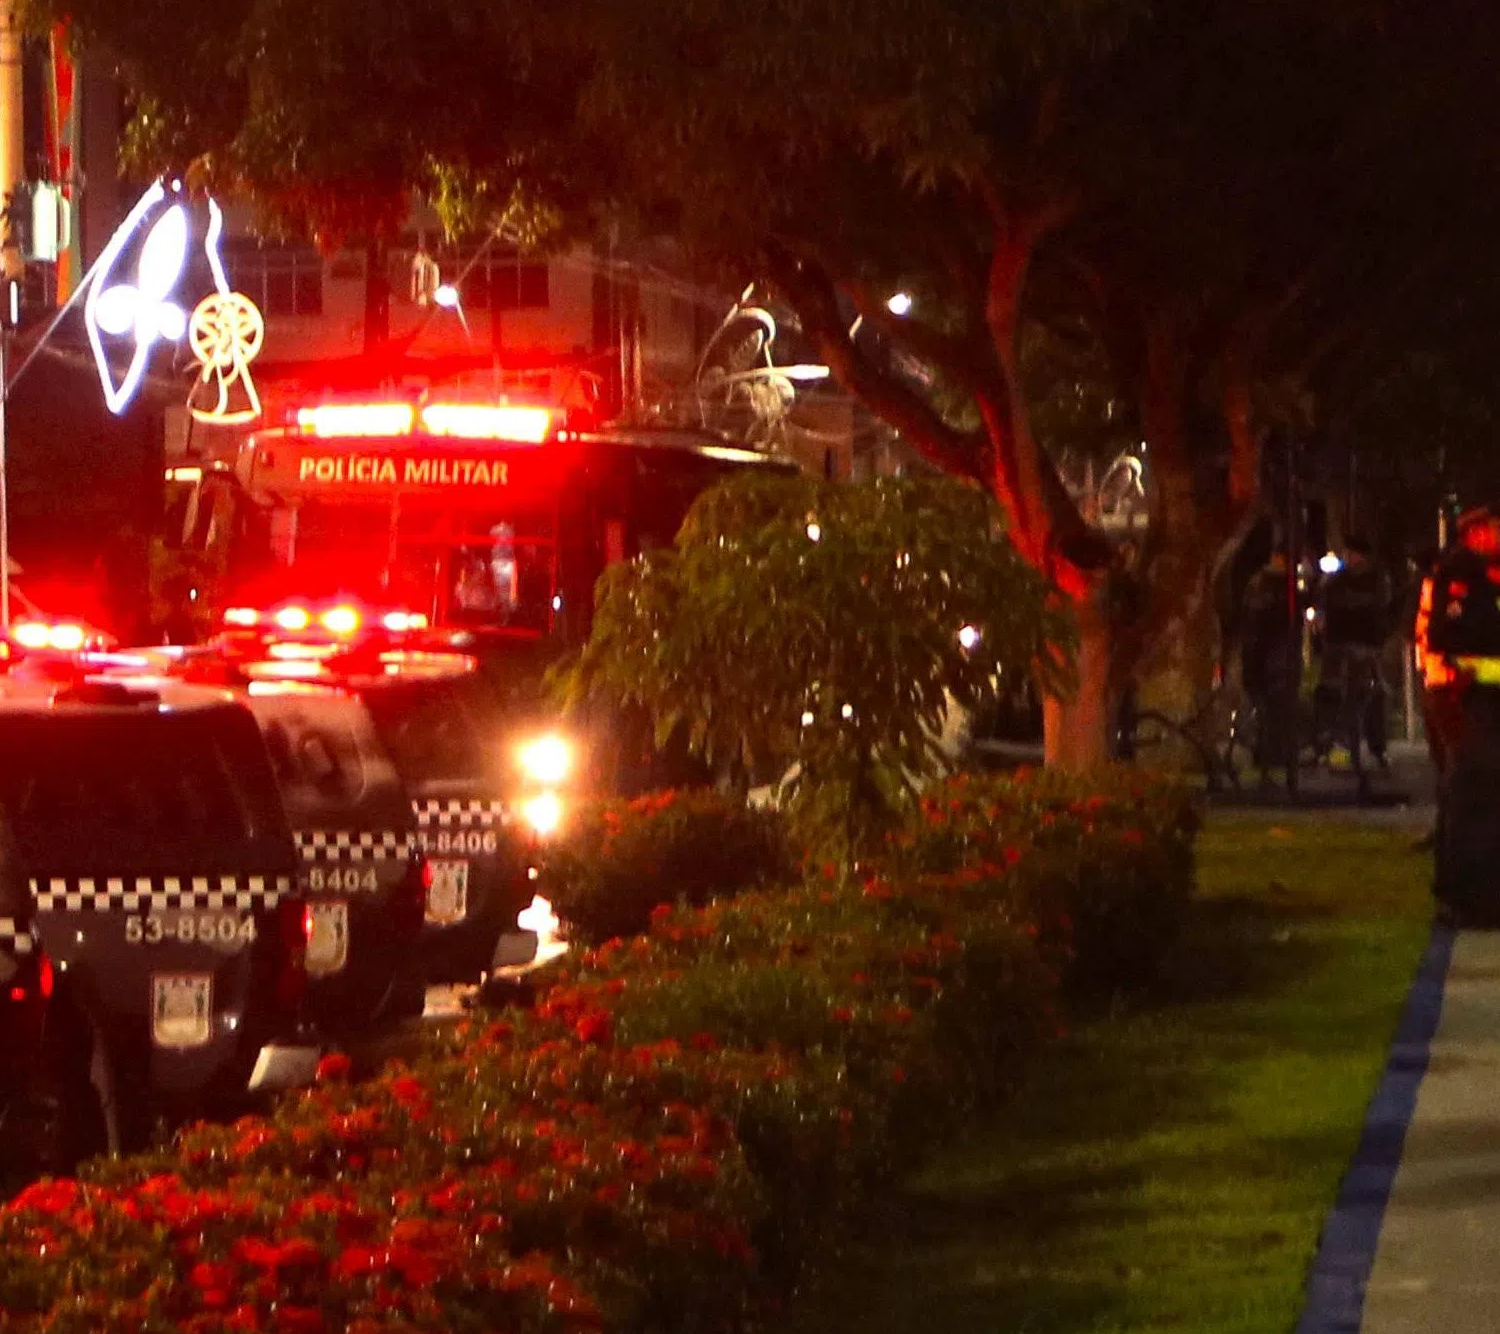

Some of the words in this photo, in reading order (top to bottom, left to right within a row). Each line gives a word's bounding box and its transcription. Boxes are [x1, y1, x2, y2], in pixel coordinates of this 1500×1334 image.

[300, 453, 398, 485] POLÍCIA
[404, 457, 509, 487] MILITAR
[125, 913, 259, 945] 53-8504
